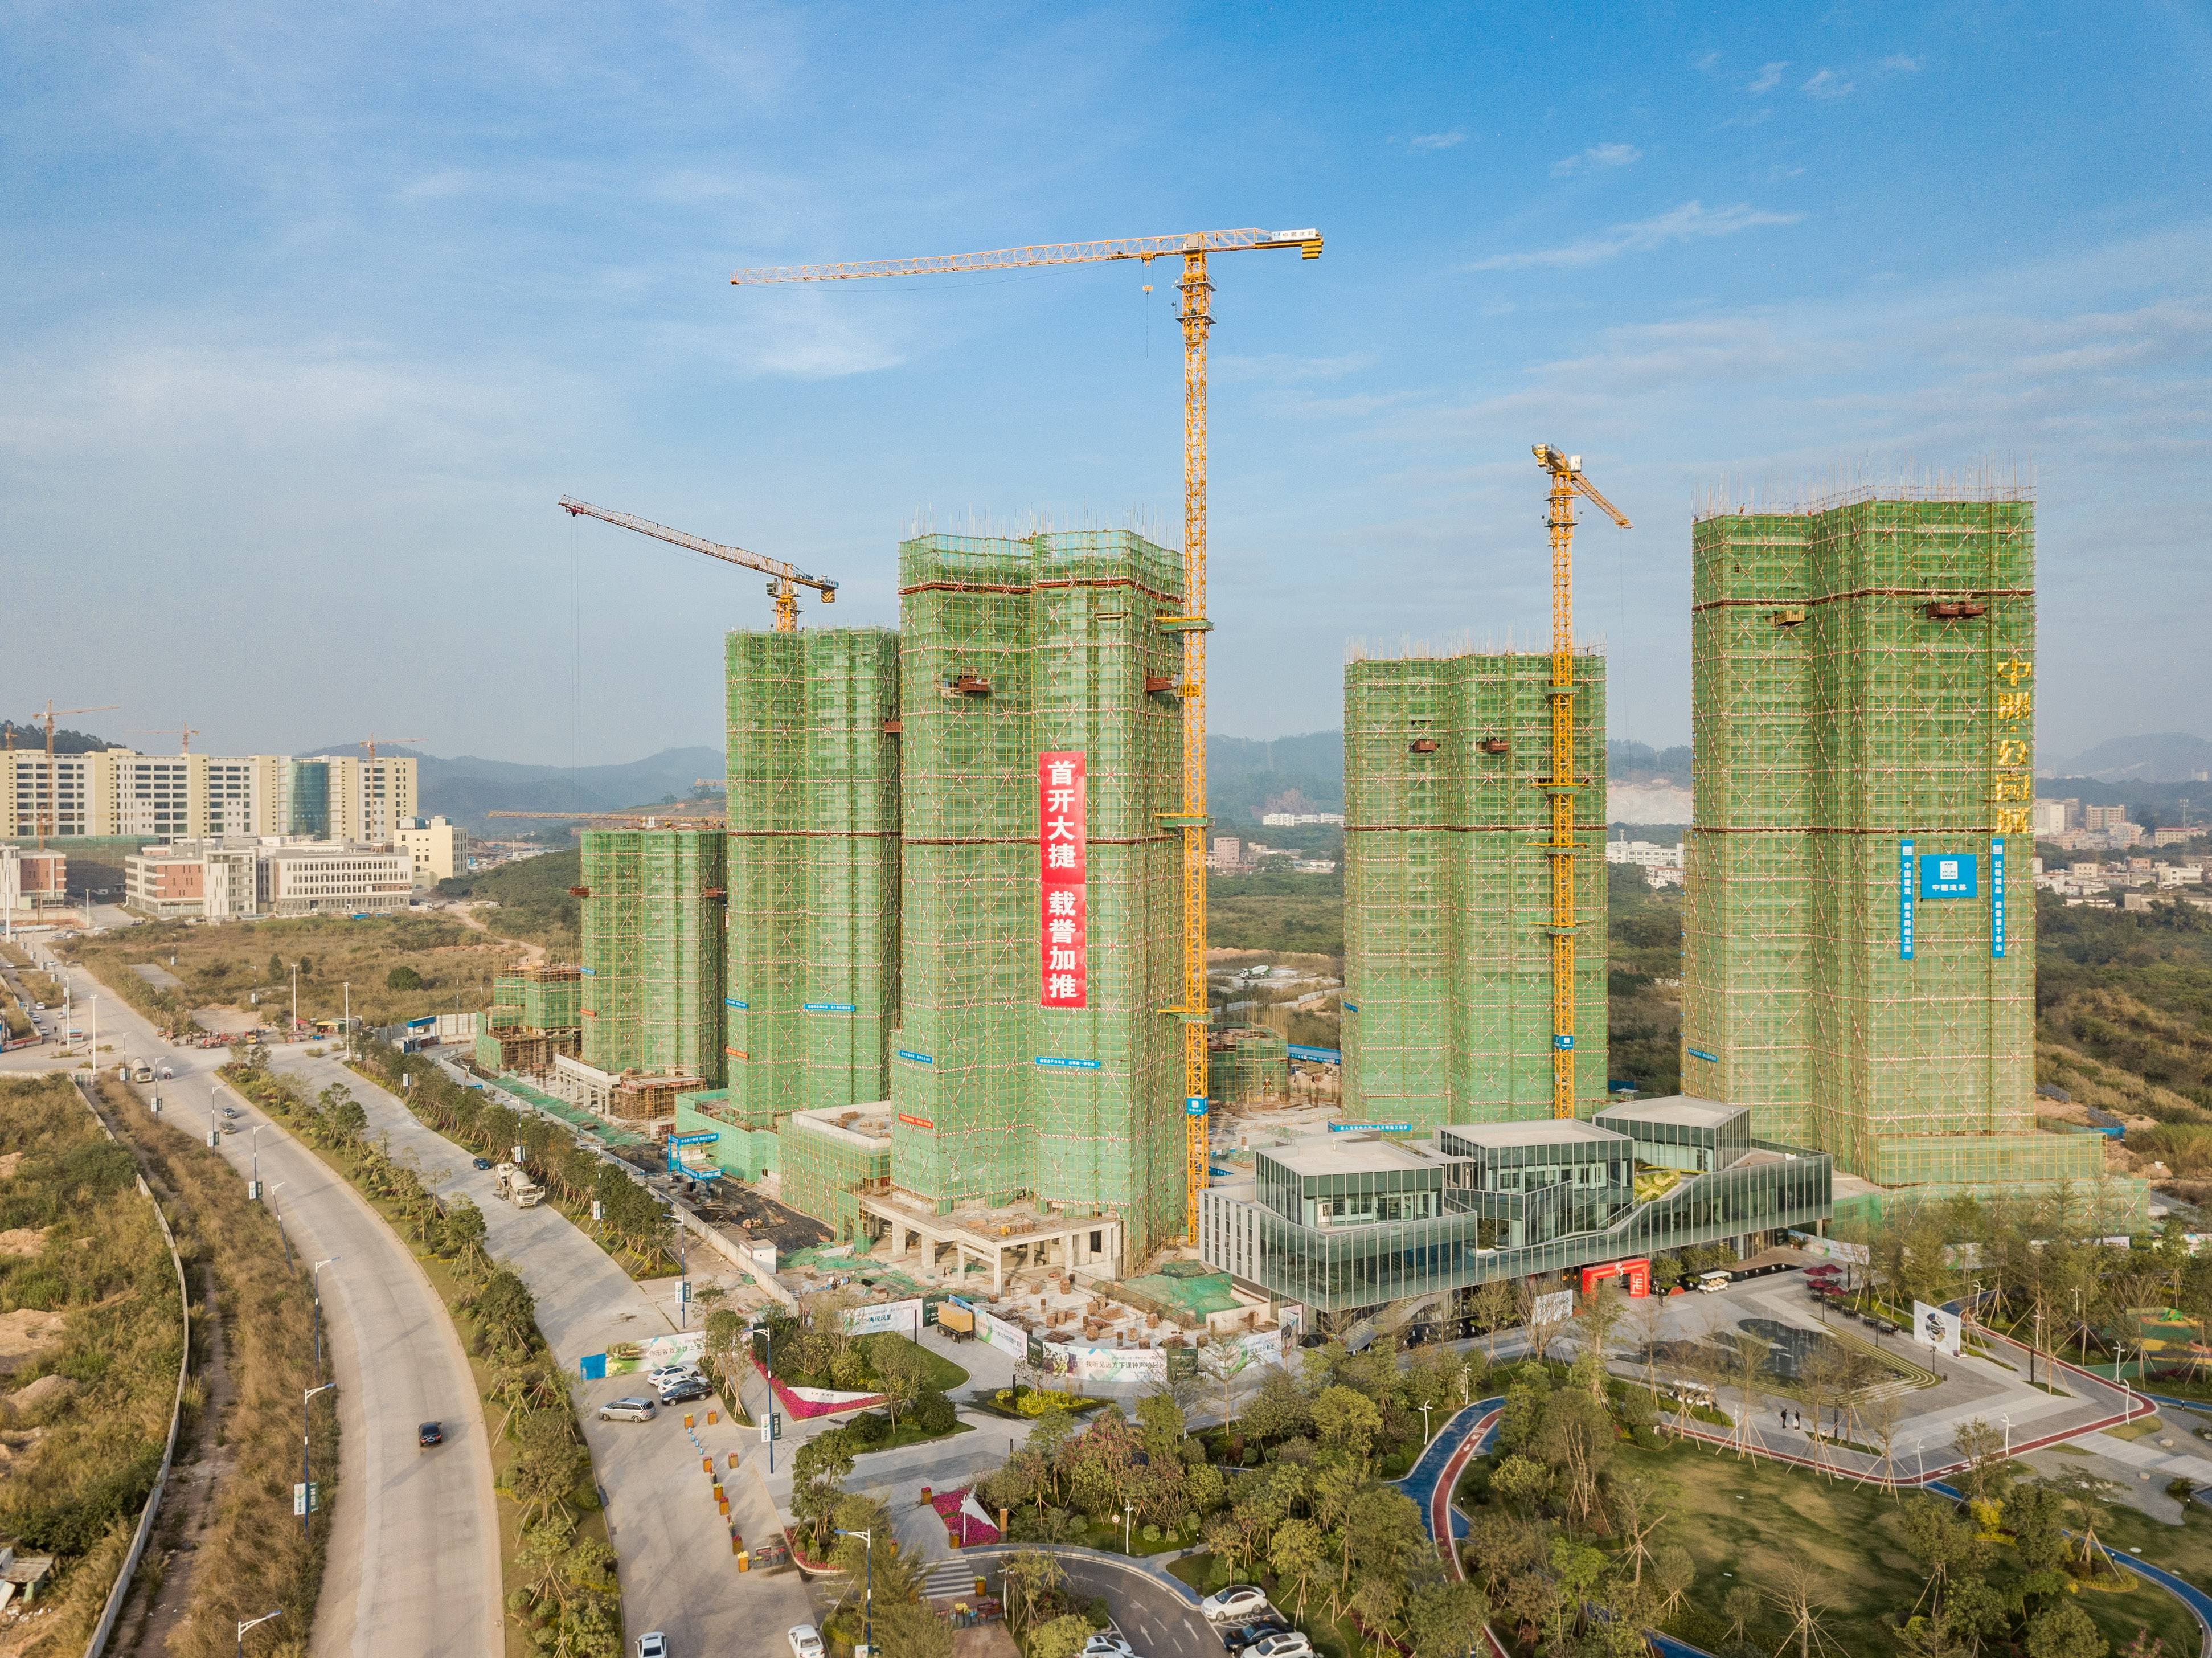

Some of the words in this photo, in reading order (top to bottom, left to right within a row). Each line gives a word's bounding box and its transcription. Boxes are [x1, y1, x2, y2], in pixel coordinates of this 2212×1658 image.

[1047, 760, 1075, 868] 首开大捷
[1048, 891, 1076, 998] 载誉加推
